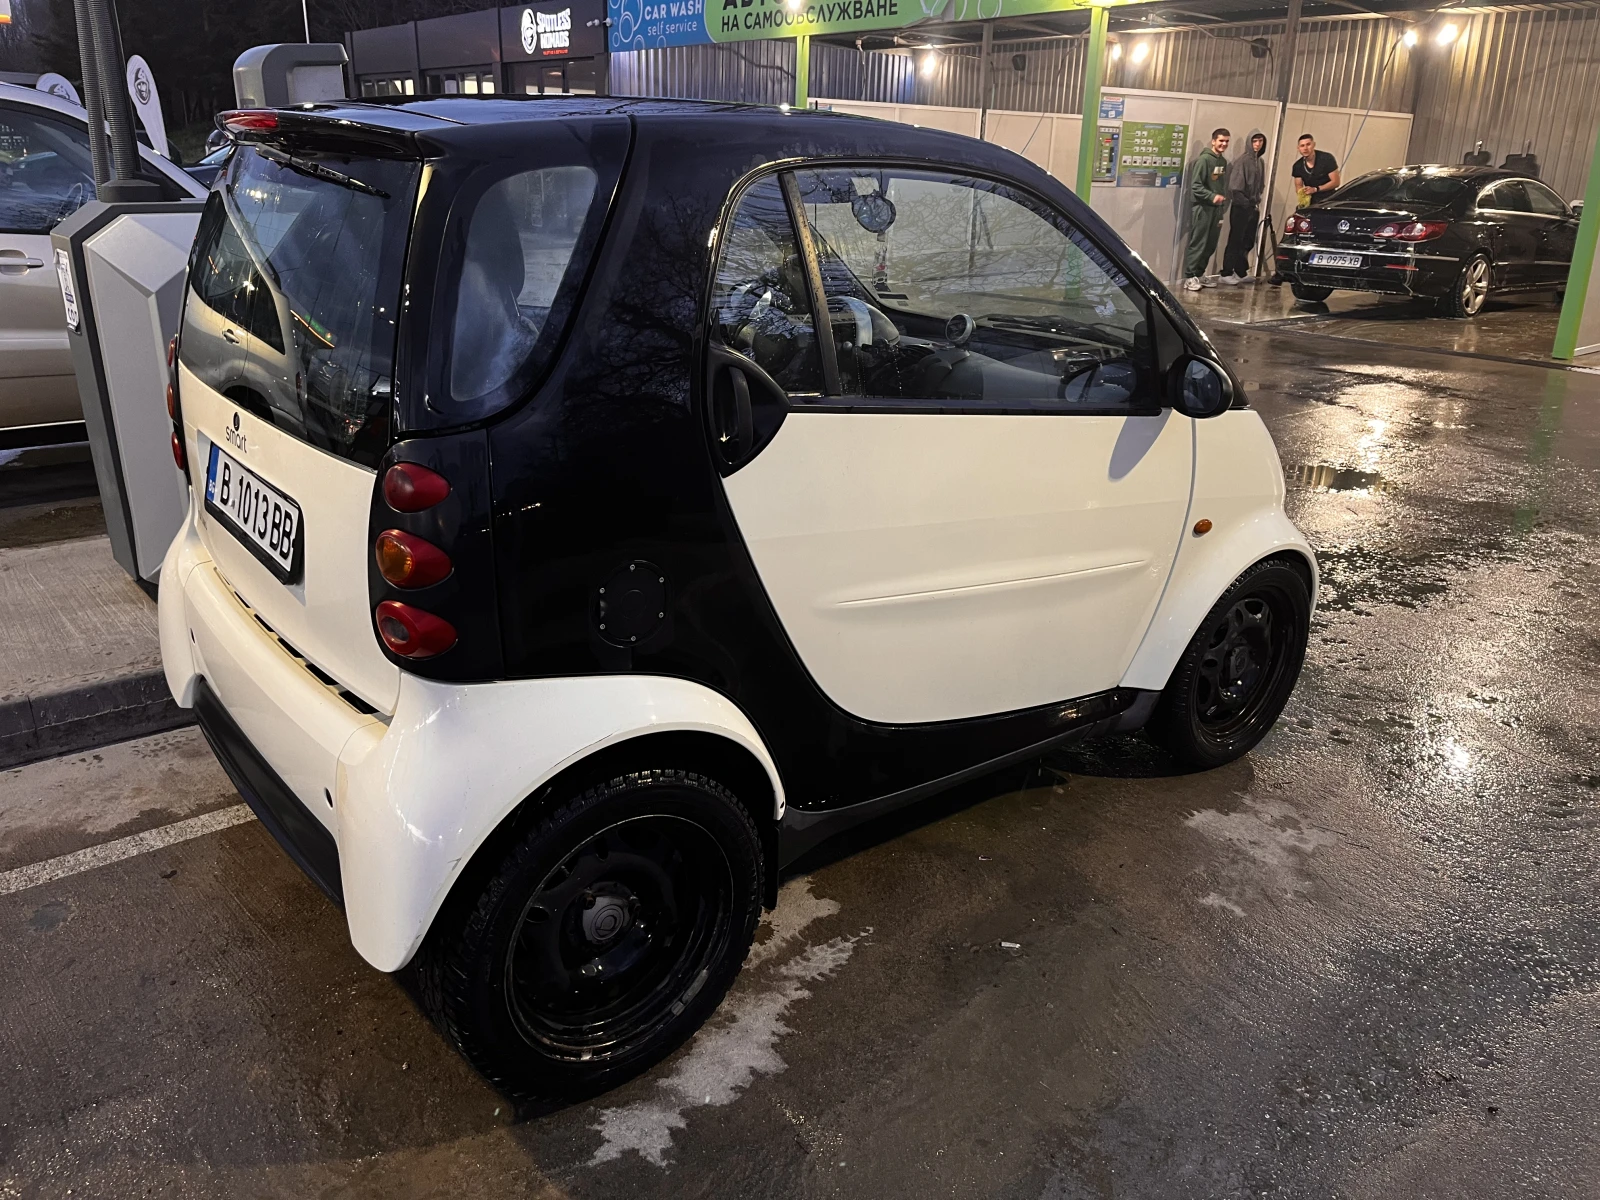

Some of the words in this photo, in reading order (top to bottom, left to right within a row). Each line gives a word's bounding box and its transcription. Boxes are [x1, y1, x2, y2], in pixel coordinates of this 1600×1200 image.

[536, 7, 571, 33] SPOTLESS
[644, 3, 667, 21] CAR
[669, 0, 703, 18] WASH
[647, 20, 664, 36] self
[665, 19, 698, 34] service
[721, 14, 740, 33] НА
[540, 30, 570, 49] NOMADS
[225, 425, 248, 454] smart
